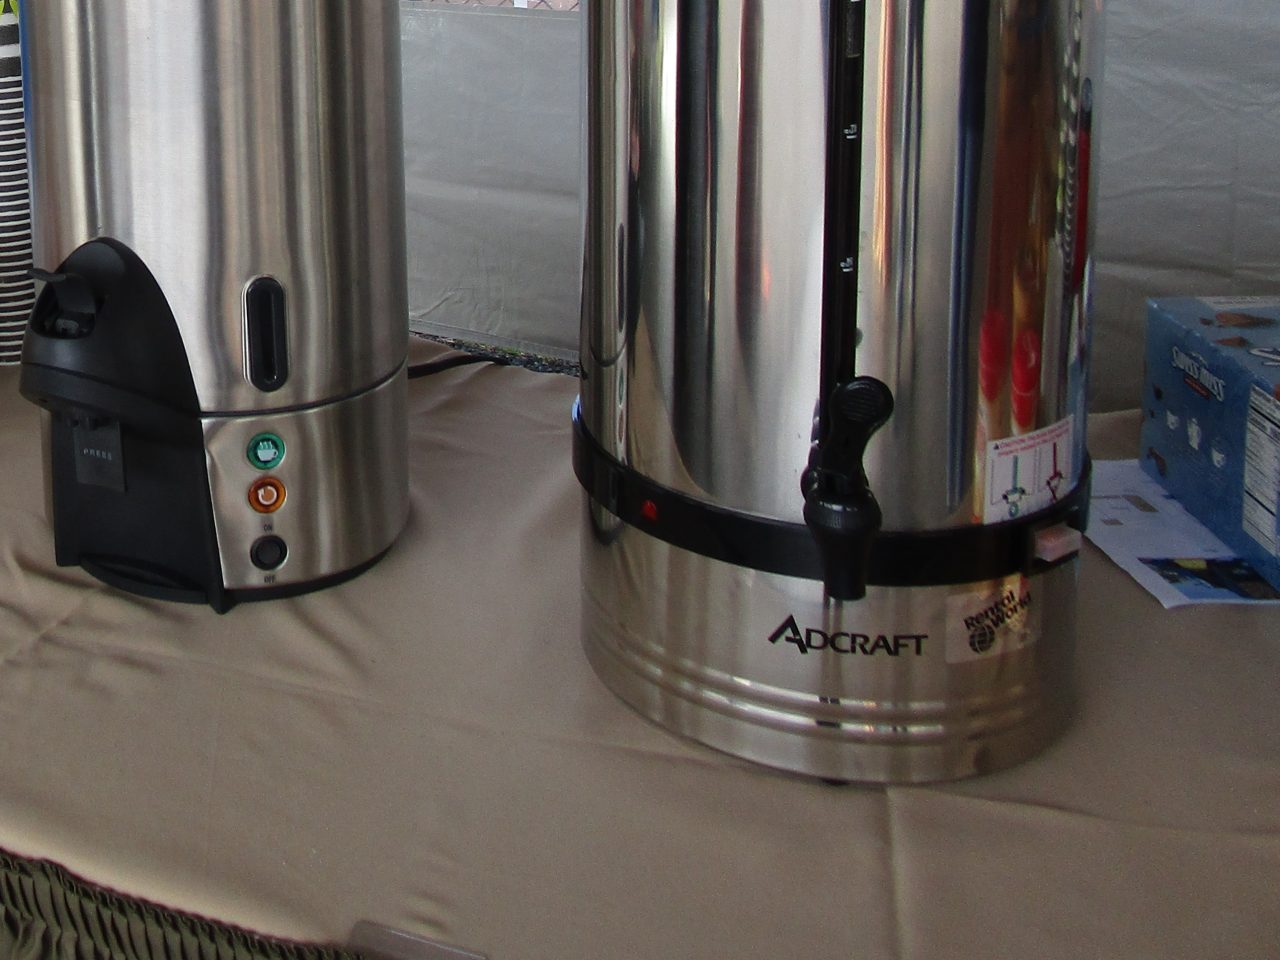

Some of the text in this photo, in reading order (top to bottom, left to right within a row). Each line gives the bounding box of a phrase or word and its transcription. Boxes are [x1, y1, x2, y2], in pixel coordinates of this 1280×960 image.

[963, 589, 1015, 630] Rental
[990, 591, 1032, 628] World
[767, 614, 929, 657] ADCRAFT
